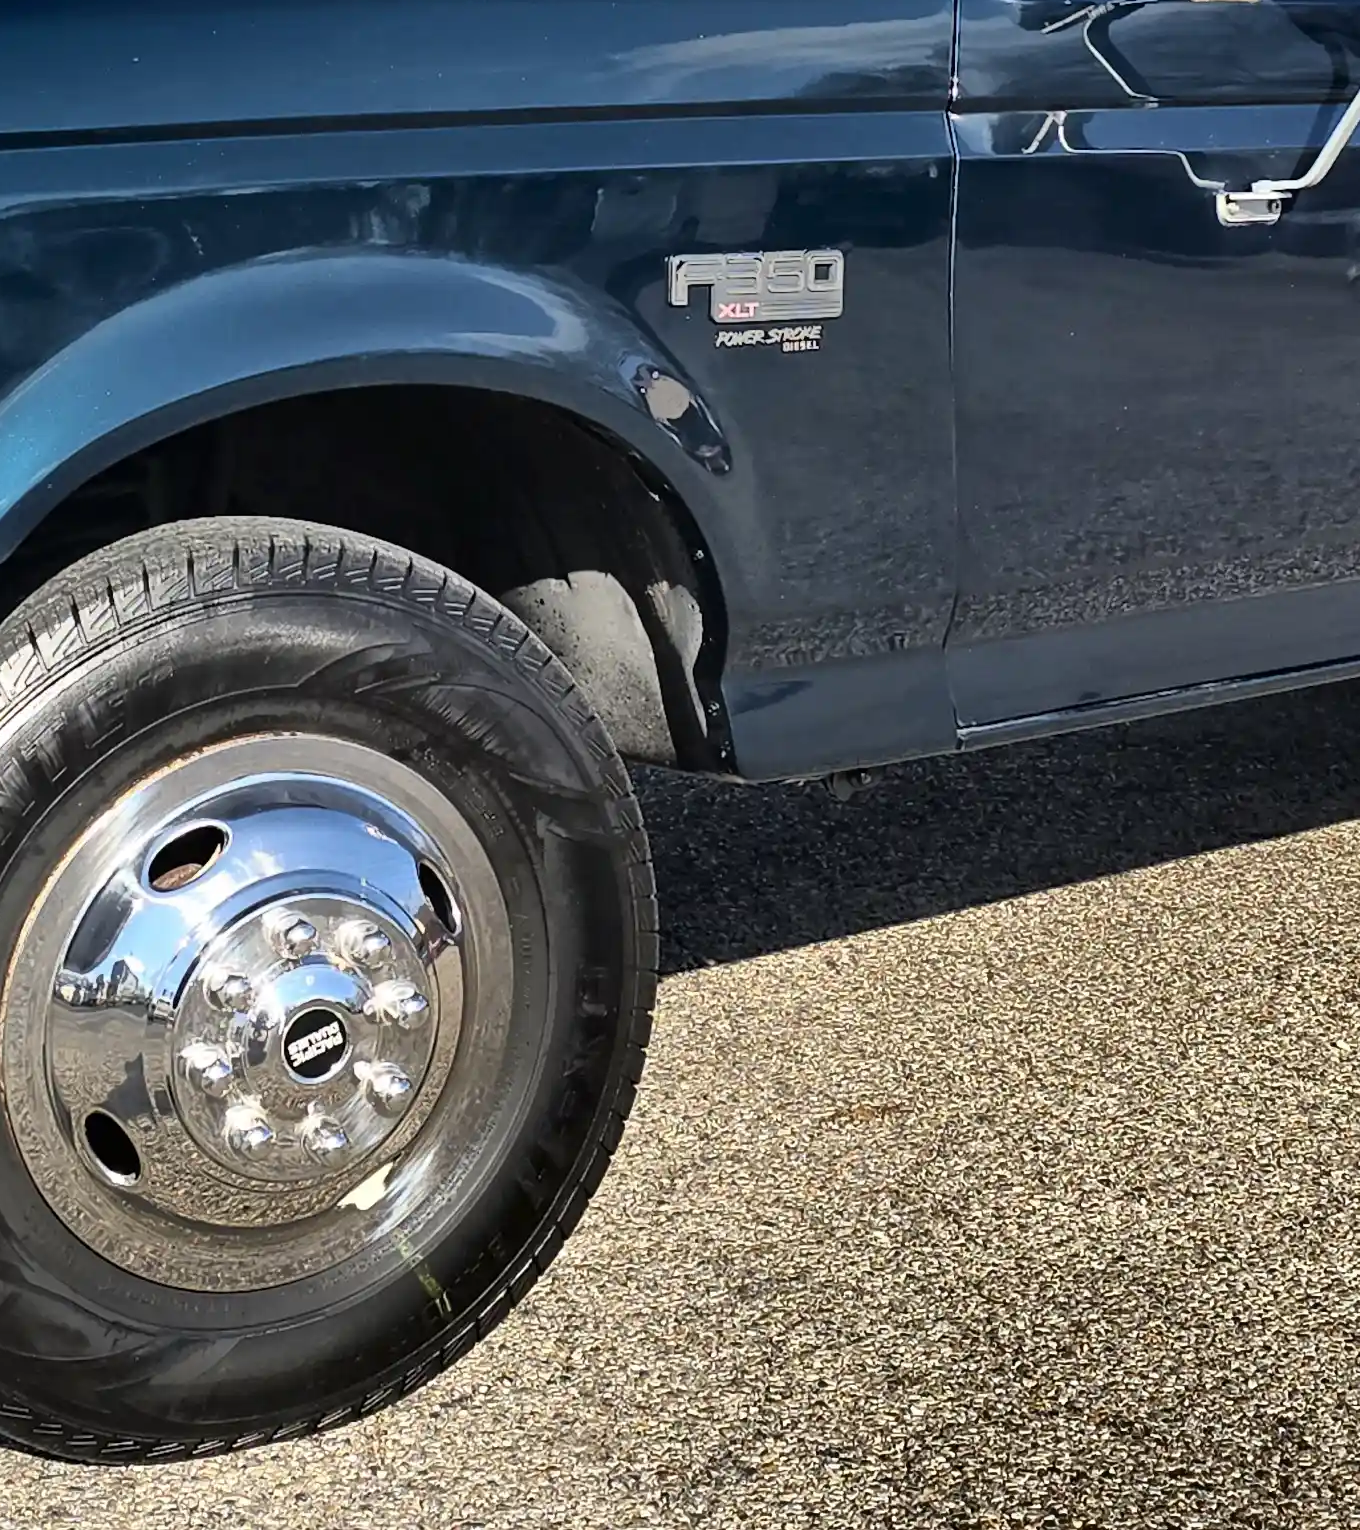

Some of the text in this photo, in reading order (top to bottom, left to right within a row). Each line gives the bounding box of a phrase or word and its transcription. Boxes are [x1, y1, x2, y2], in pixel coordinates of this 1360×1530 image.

[667, 249, 844, 306] F350
[718, 302, 760, 319] XLT
[715, 325, 822, 348] POWER STROKE
[782, 340, 820, 352] DIESEL
